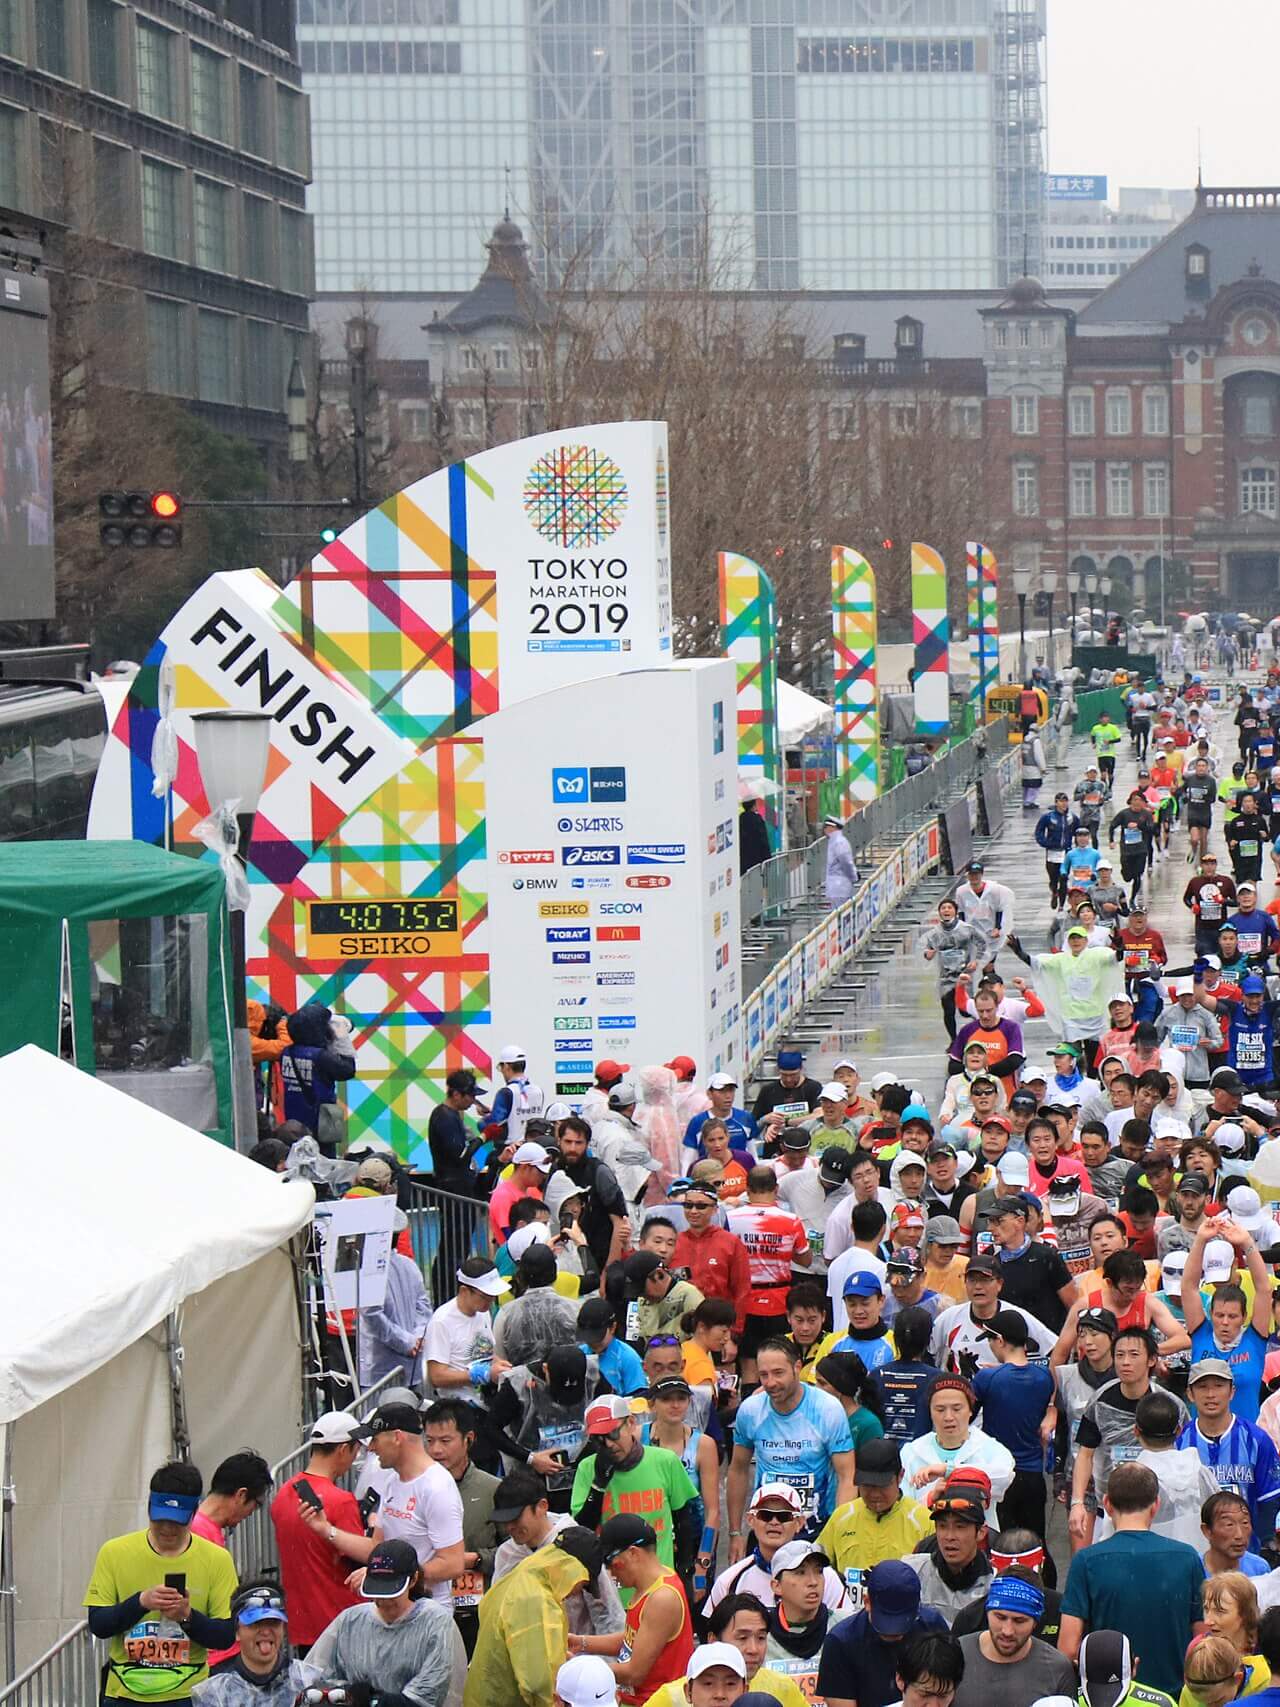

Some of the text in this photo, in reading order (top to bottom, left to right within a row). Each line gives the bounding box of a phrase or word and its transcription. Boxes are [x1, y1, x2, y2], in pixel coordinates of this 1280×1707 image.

[528, 559, 628, 580] TOKYO
[530, 585, 627, 598] MARATHON
[529, 603, 629, 635] 2019
[189, 607, 376, 785] FINISH
[526, 879, 558, 889] BMW
[541, 905, 588, 916] SEIKO
[600, 904, 642, 914] SECOM
[340, 937, 430, 955] SEIKO
